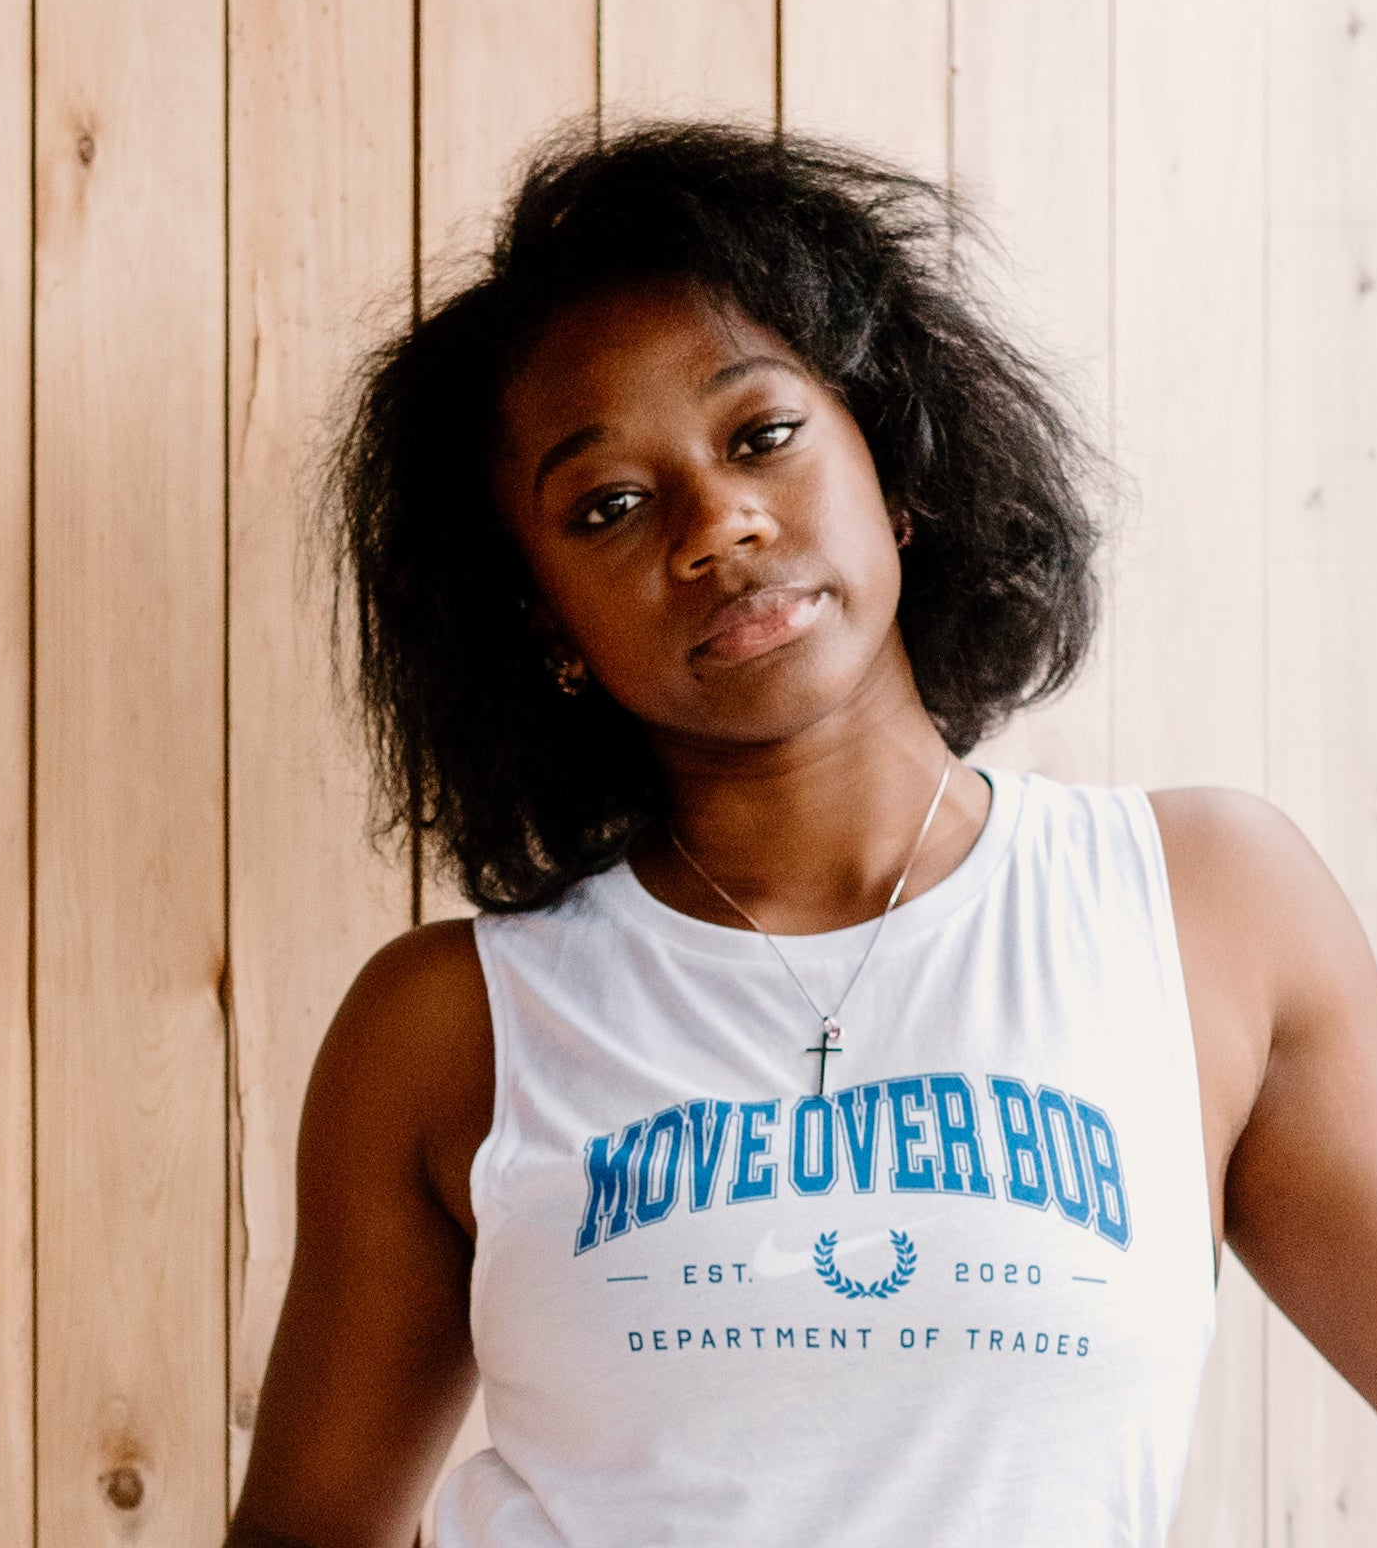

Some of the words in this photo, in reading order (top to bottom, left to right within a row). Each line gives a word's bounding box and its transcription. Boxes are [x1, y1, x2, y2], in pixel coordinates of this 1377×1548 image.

[574, 1097, 782, 1256] MOVE
[787, 1072, 997, 1199] OVER
[986, 1073, 1134, 1252] BOB
[682, 1263, 755, 1285] EST.
[954, 1262, 1042, 1285] 2020
[628, 1327, 872, 1352] DEPARTMENT
[899, 1327, 941, 1350] OF
[966, 1328, 1091, 1358] TRADES
